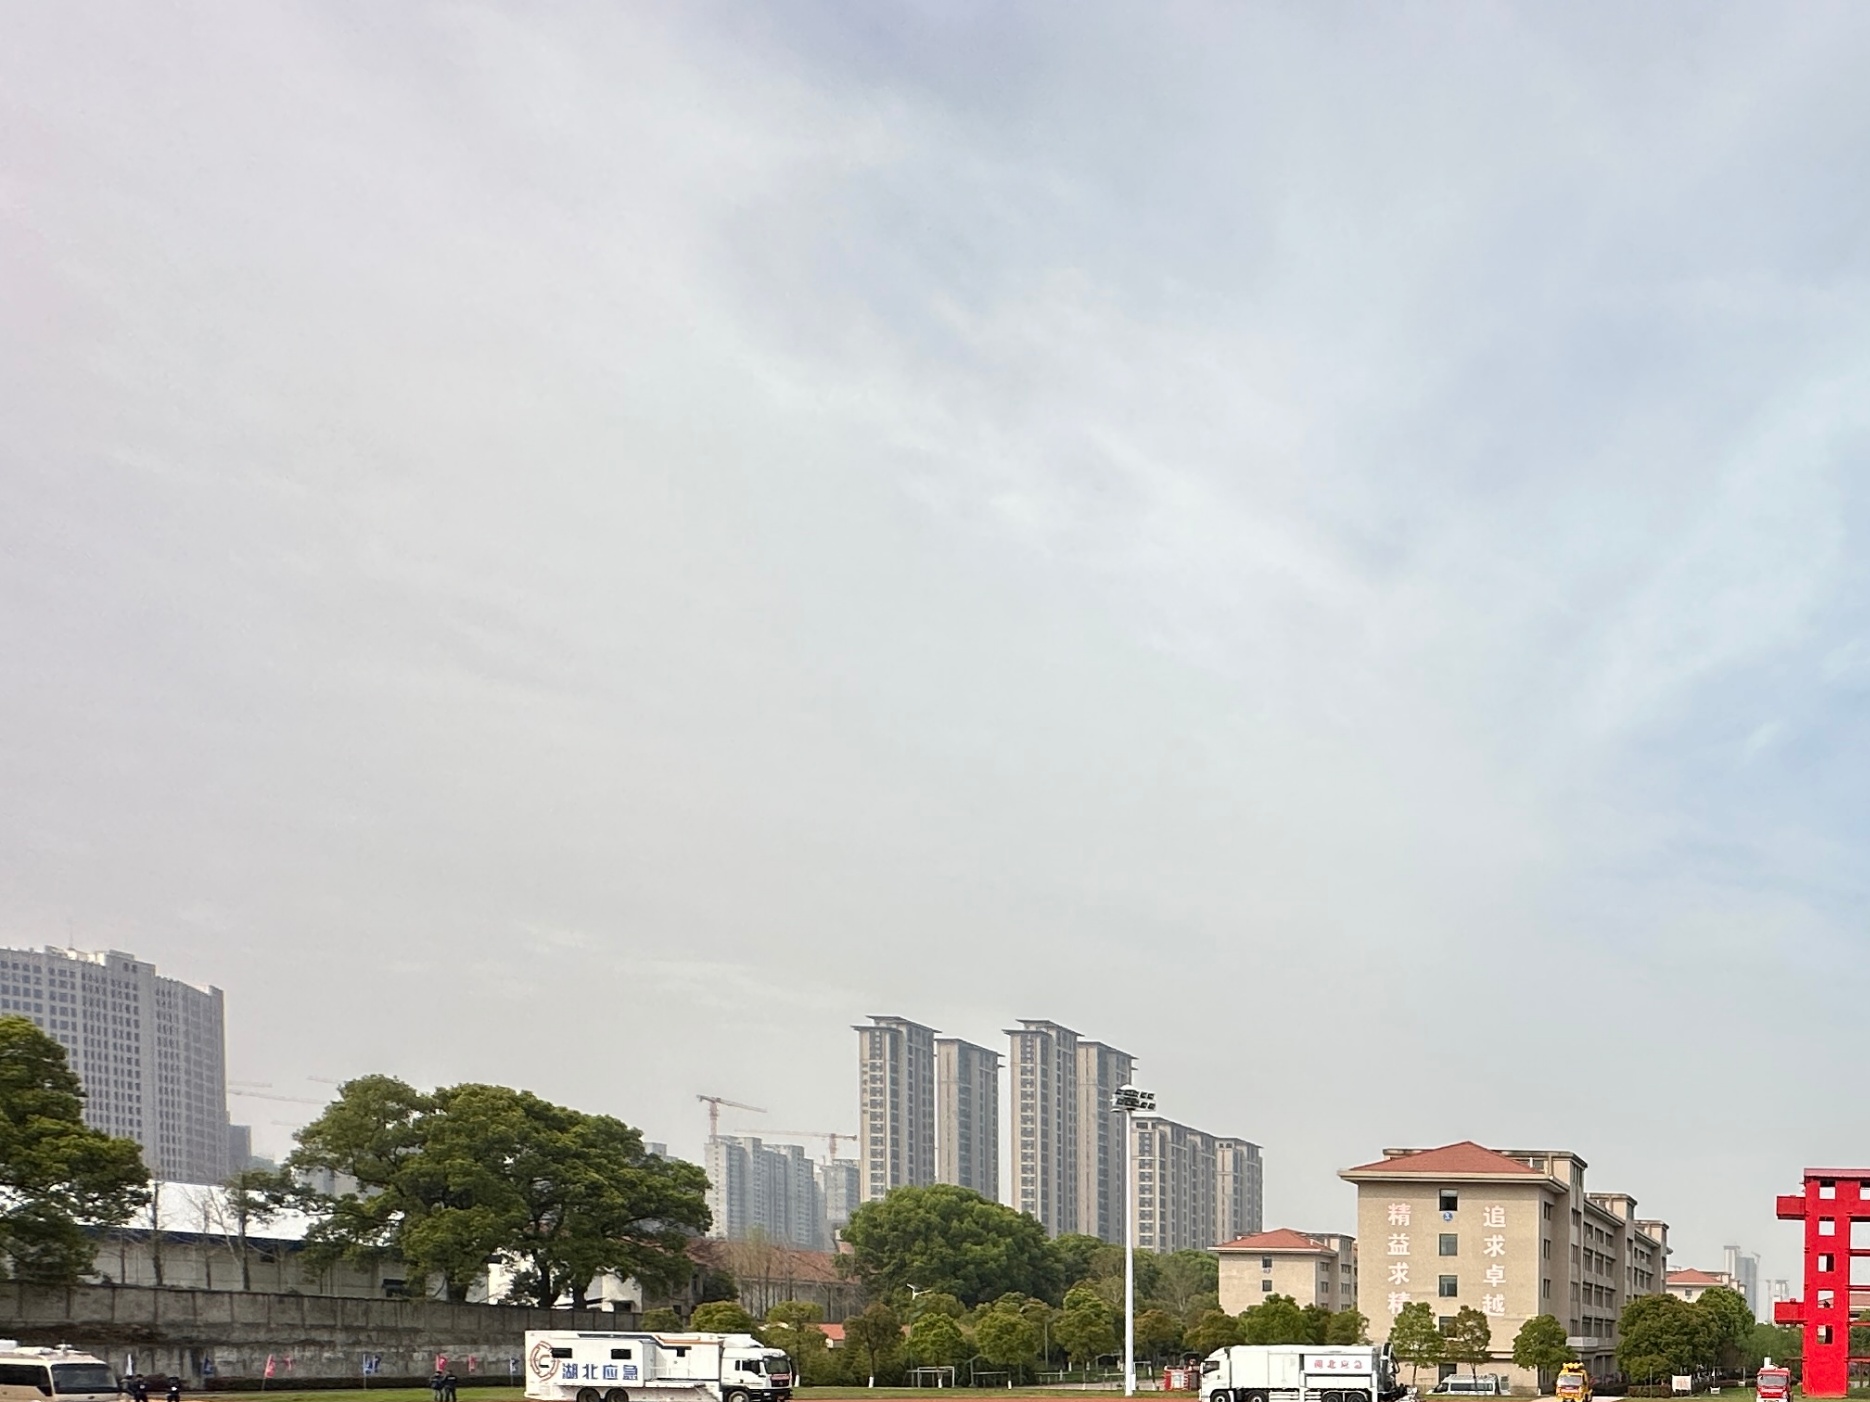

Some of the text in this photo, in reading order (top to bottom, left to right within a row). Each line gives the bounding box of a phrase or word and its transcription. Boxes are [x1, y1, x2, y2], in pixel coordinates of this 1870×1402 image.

[1482, 1205, 1507, 1317] 追求卓越
[562, 1363, 638, 1380] 湖北应急
